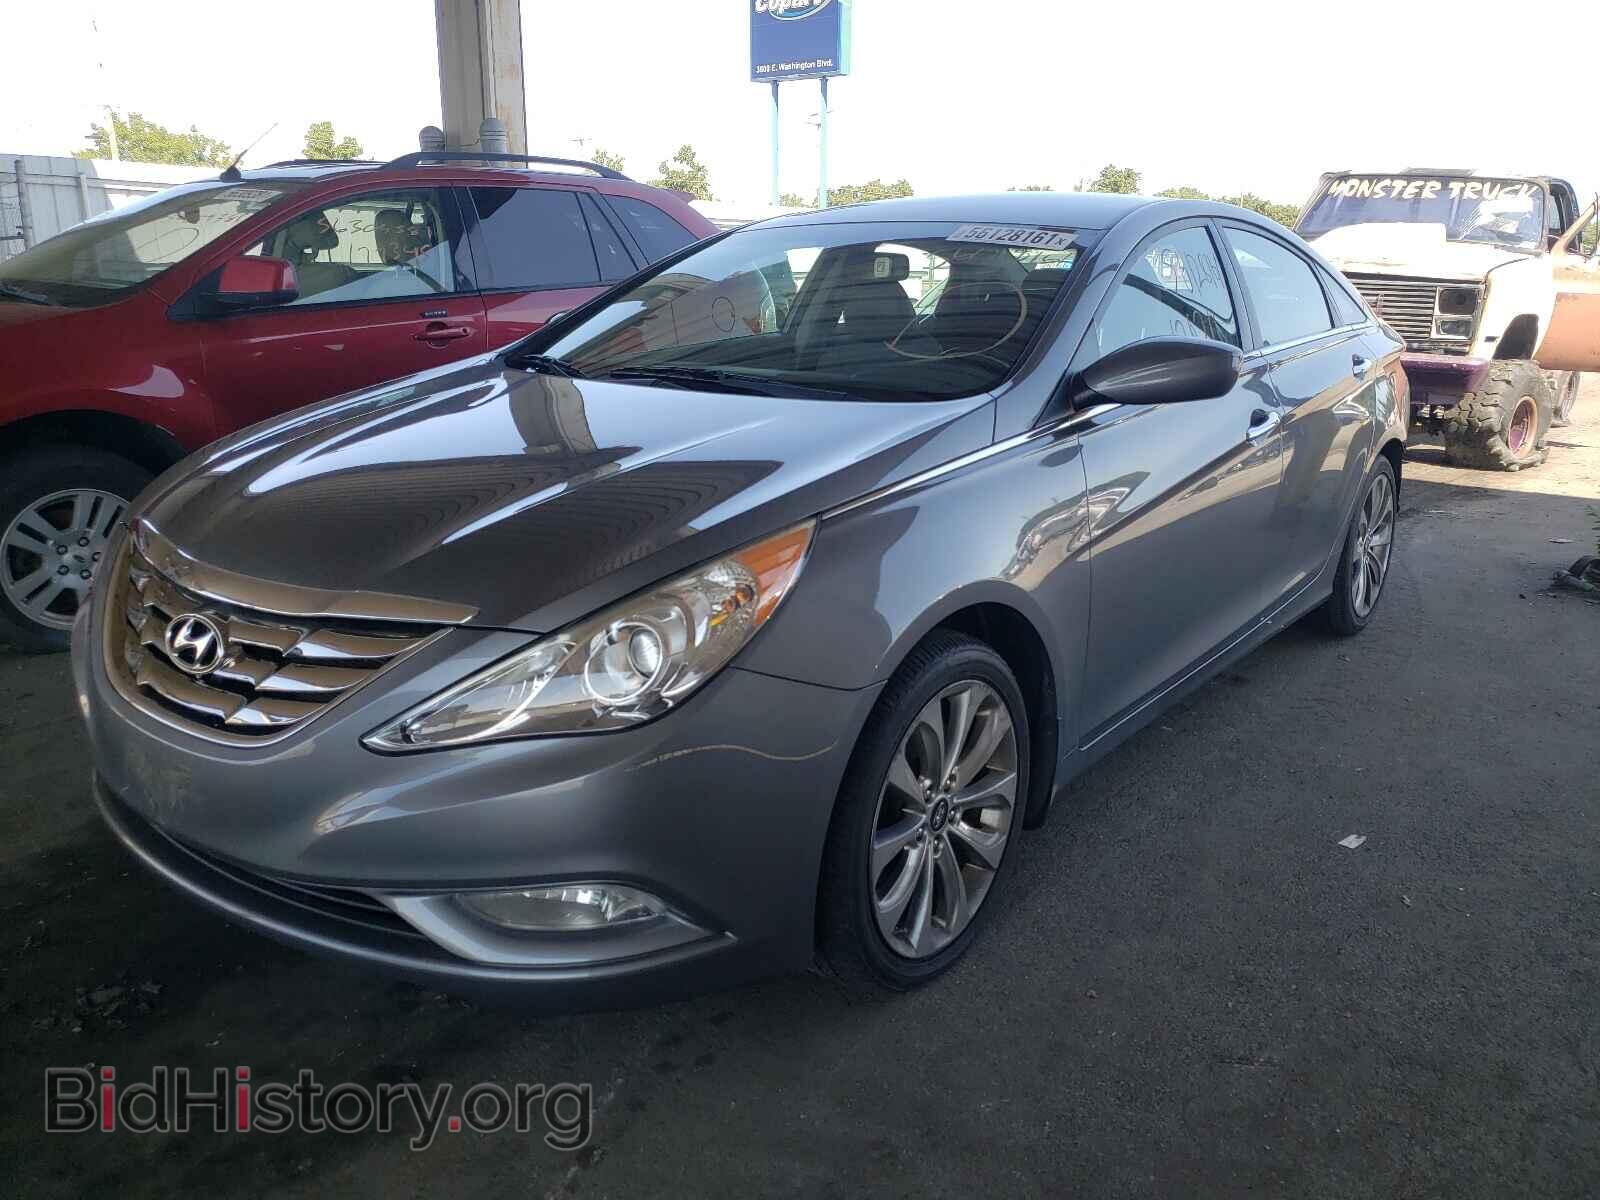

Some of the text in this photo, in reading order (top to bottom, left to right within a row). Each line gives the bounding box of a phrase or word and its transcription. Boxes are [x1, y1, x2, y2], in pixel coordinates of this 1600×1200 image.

[779, 61, 816, 71] Washington
[1329, 179, 1539, 200] MONSTER TRUCK
